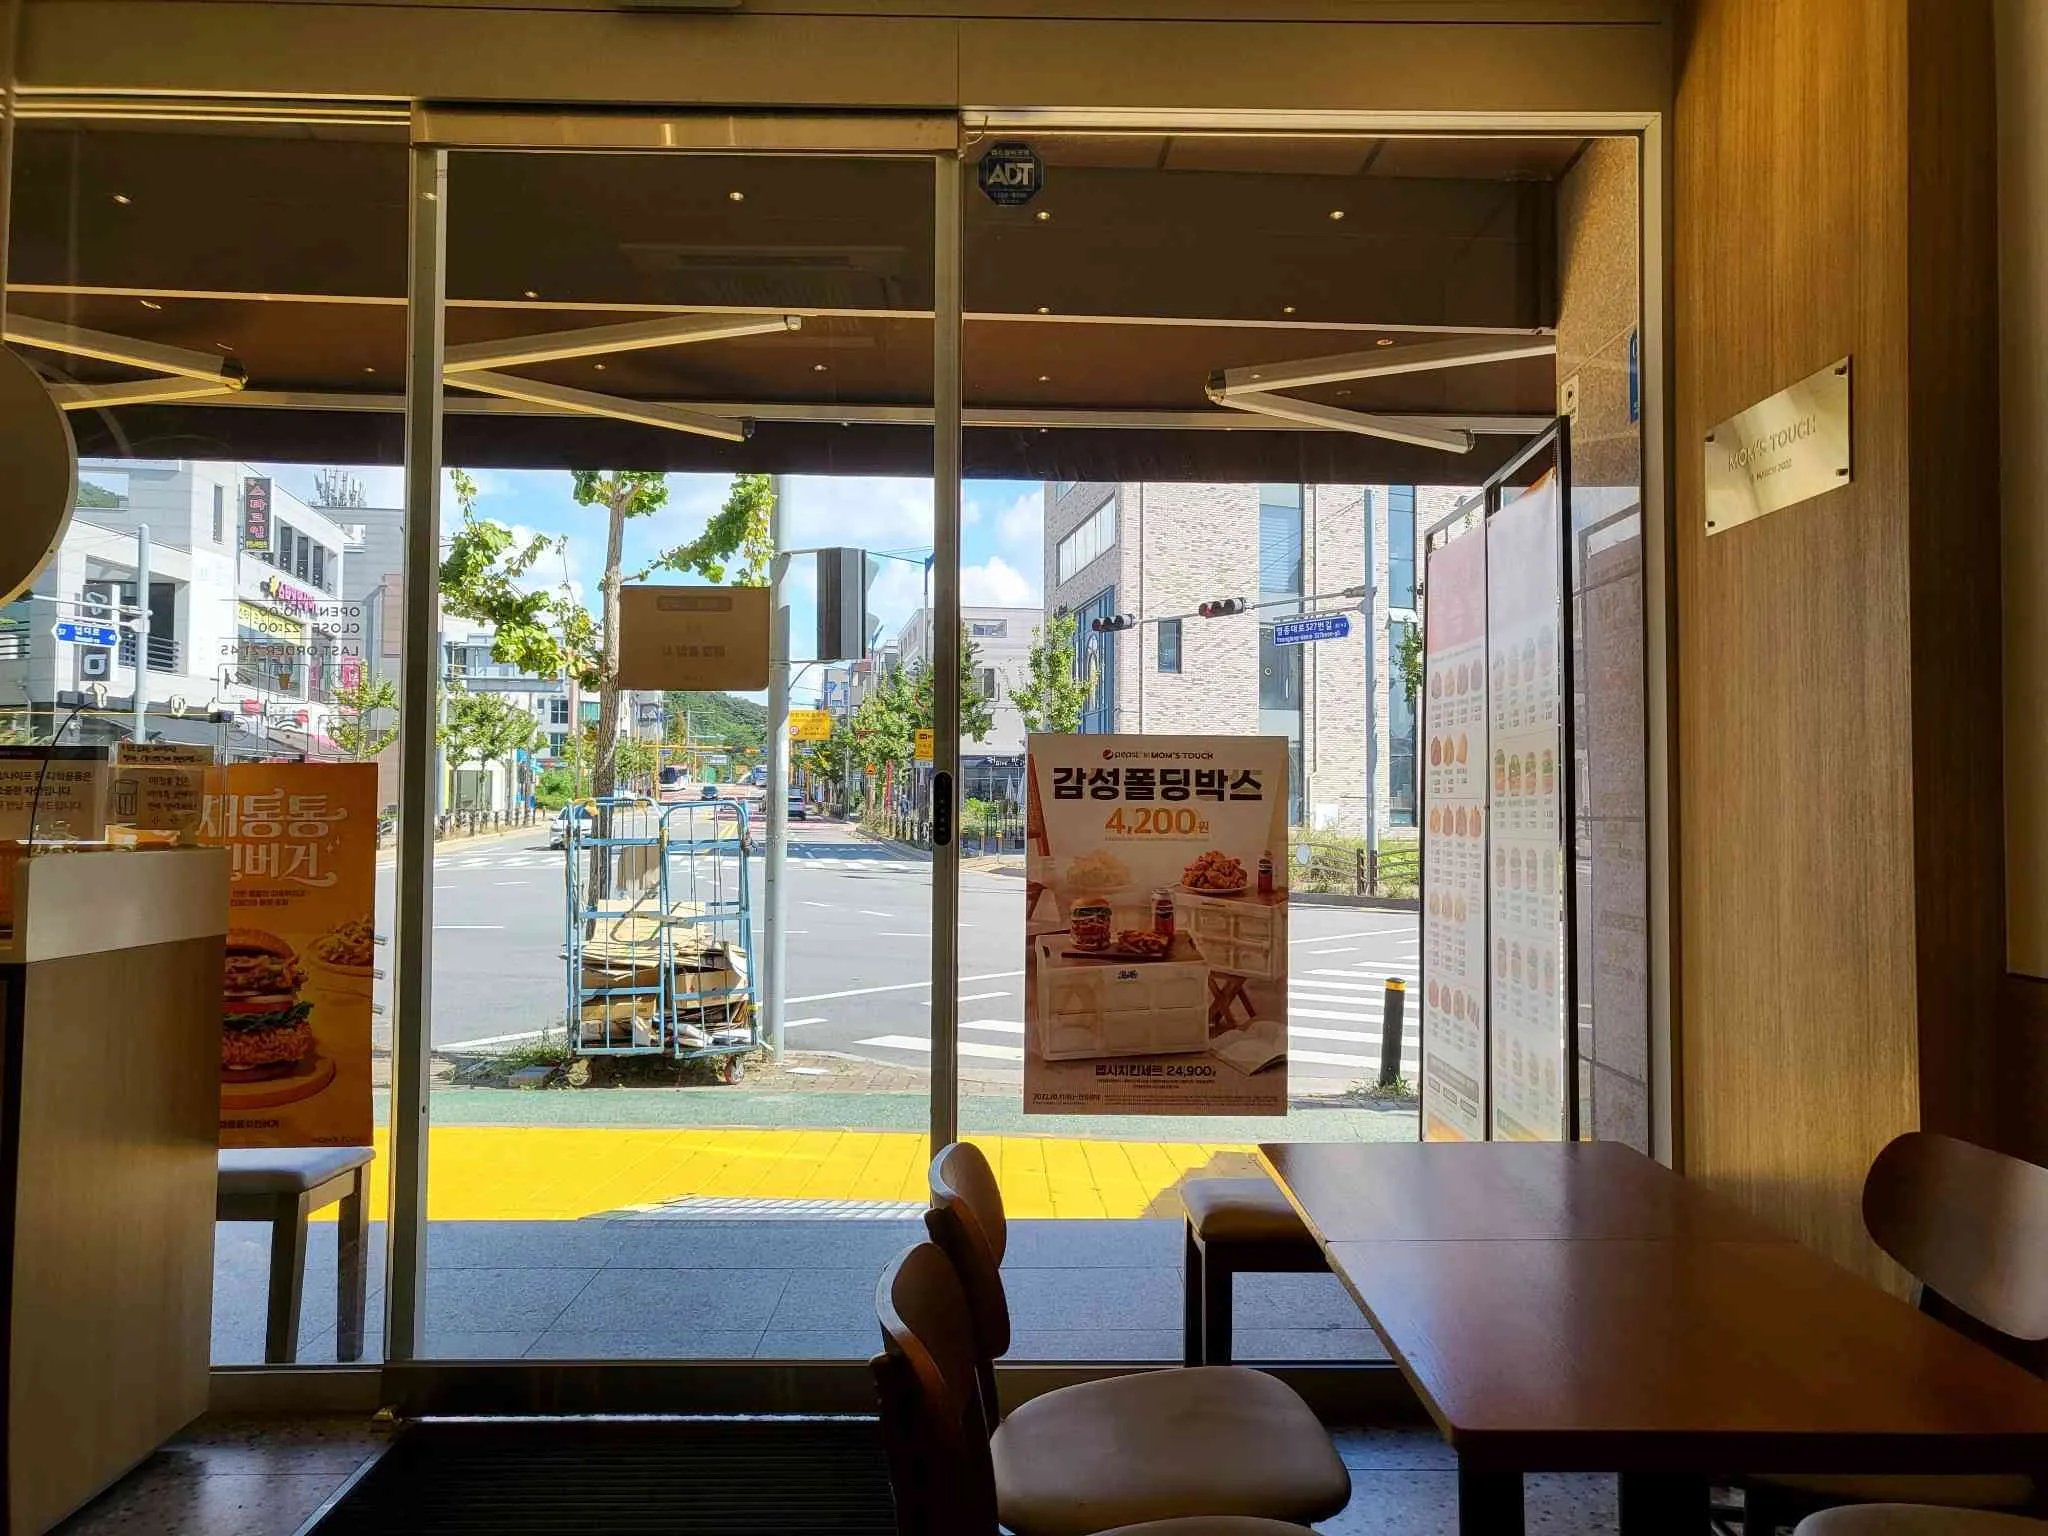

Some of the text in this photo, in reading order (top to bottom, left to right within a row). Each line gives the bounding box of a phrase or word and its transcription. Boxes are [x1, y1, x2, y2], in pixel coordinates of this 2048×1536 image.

[988, 163, 1034, 185] ADT
[1728, 414, 1816, 472] MOM'S TOUCH
[1151, 751, 1181, 760] MOM'S
[1182, 751, 1213, 760] TOUCH
[1053, 767, 1263, 801] 감성폴딩박스
[1104, 807, 1210, 835] 4,200원
[1095, 1064, 1163, 1077] 펩시치킨세트
